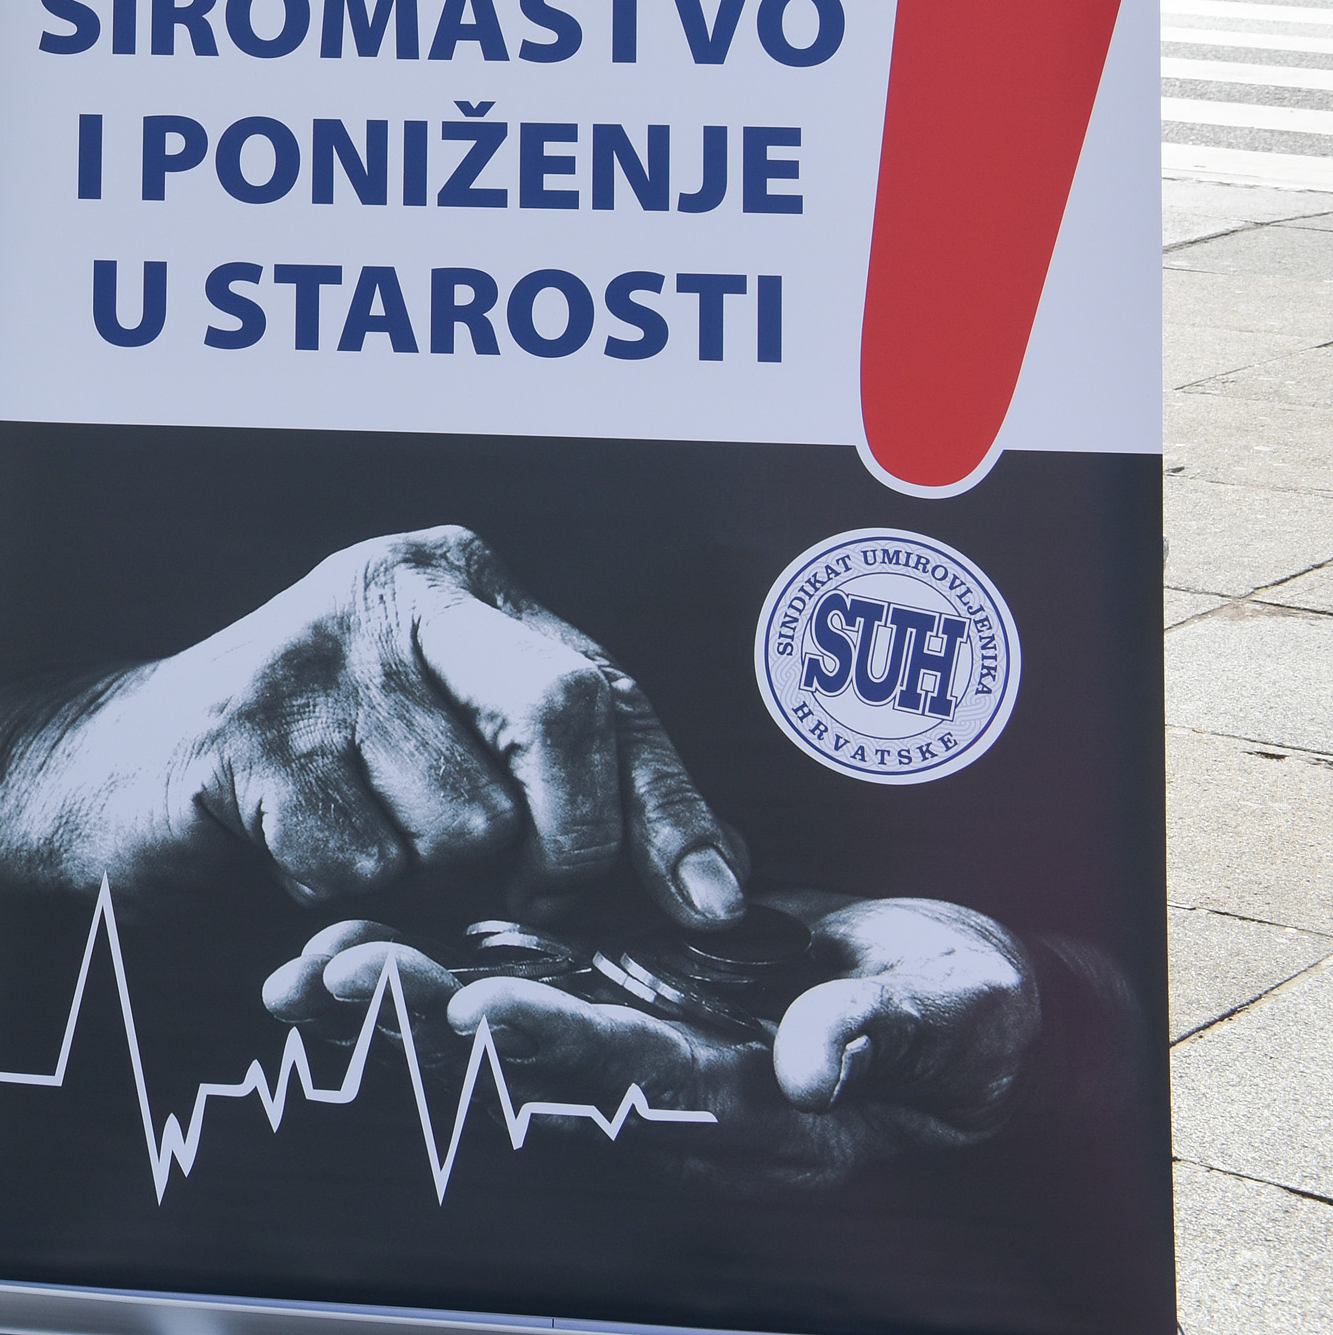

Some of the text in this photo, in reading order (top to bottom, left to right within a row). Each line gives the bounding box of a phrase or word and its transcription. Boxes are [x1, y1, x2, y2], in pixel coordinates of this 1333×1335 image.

[77, 100, 804, 215] I PONIŽENJE
[92, 259, 782, 364] U STAROSTI
[777, 548, 998, 697] SINDIKAT UMIROVLJENIKA
[799, 589, 971, 722] SUH
[791, 700, 958, 766] HRVATSKE
